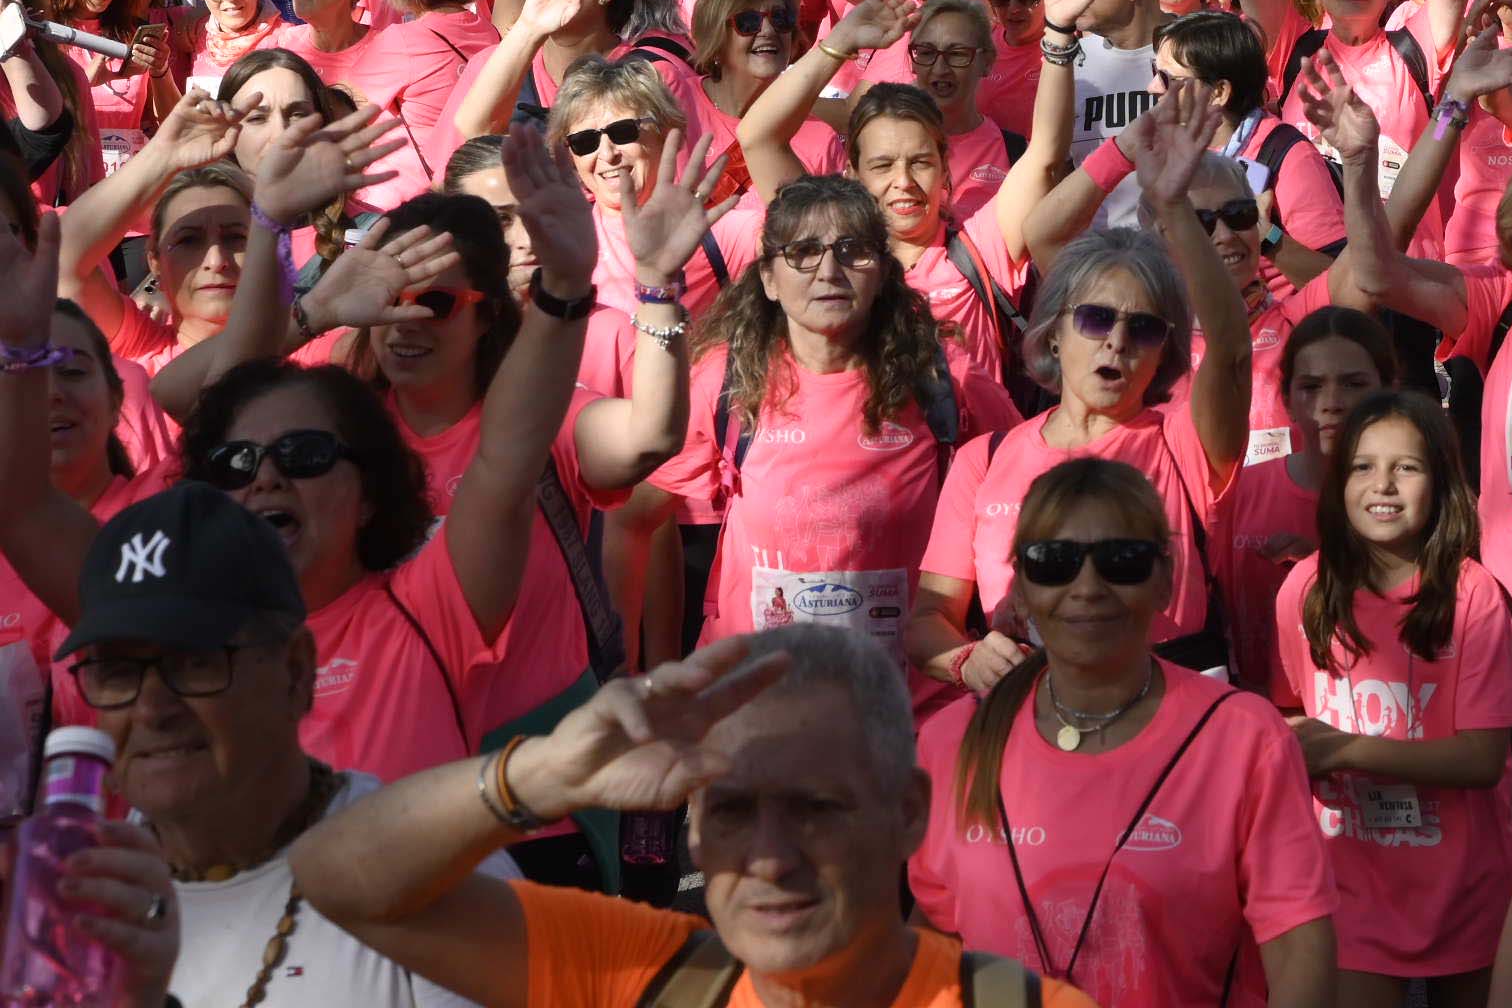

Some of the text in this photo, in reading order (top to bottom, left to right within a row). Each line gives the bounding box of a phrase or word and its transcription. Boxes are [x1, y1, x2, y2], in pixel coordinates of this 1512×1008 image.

[1254, 446, 1281, 456] SUMA
[116, 530, 171, 584] NY
[799, 594, 859, 608] ASTURIANA
